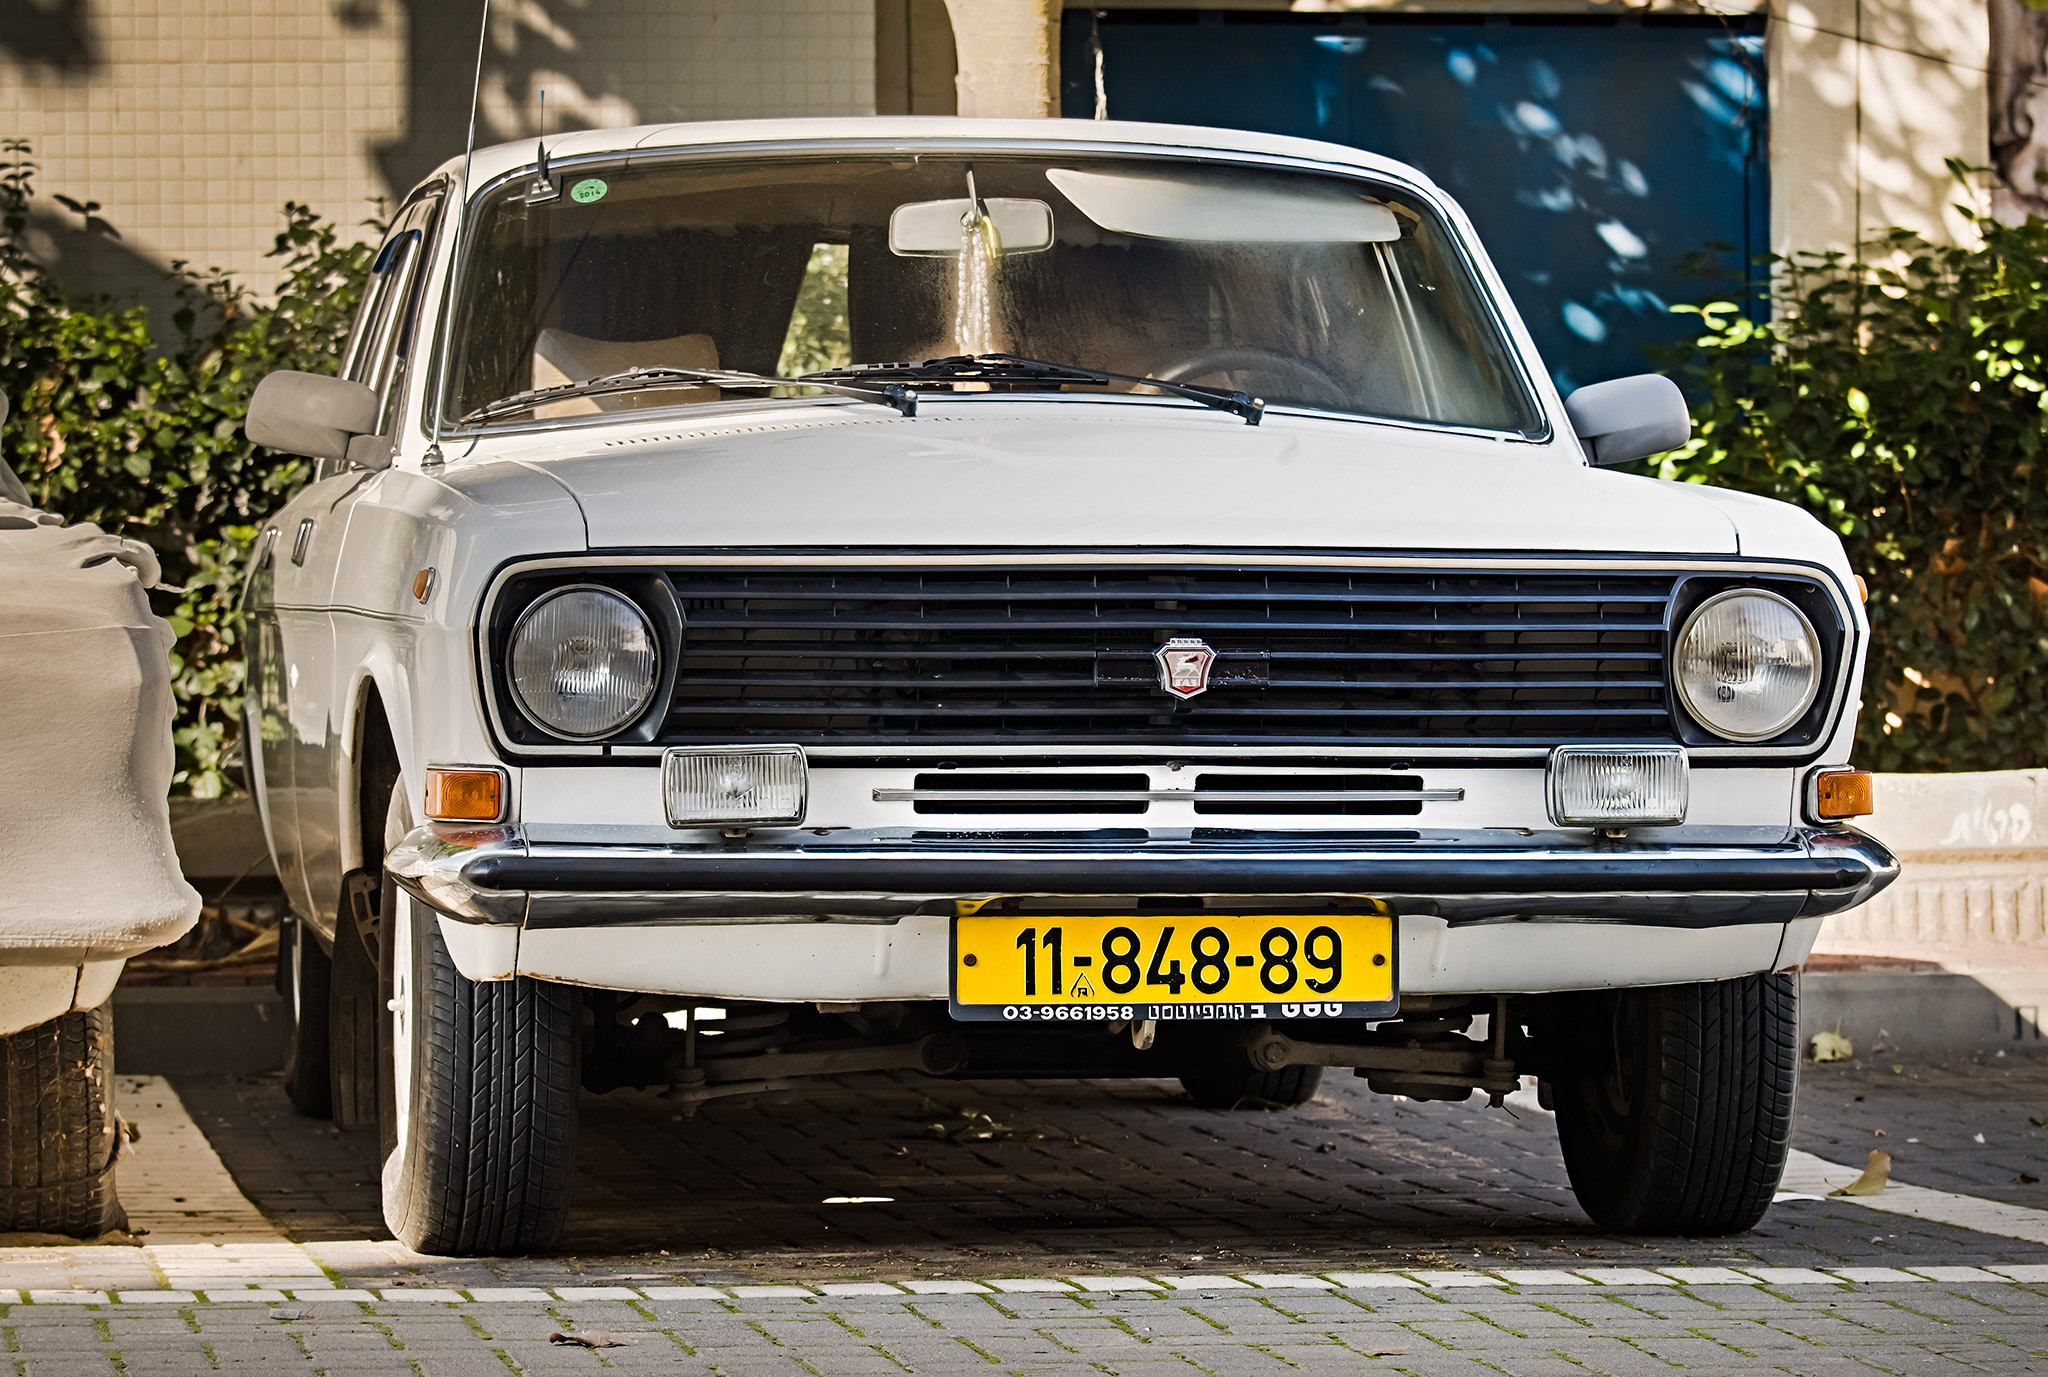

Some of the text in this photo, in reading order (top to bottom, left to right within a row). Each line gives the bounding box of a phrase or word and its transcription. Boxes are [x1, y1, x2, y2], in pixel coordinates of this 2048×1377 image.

[579, 190, 601, 199] 2014
[1016, 925, 1343, 996] 11-848-89
[1002, 1005, 1134, 1020] 03-9661958
[1148, 1004, 1245, 1020] קומפיוטסט
[1250, 1004, 1267, 1019] ב
